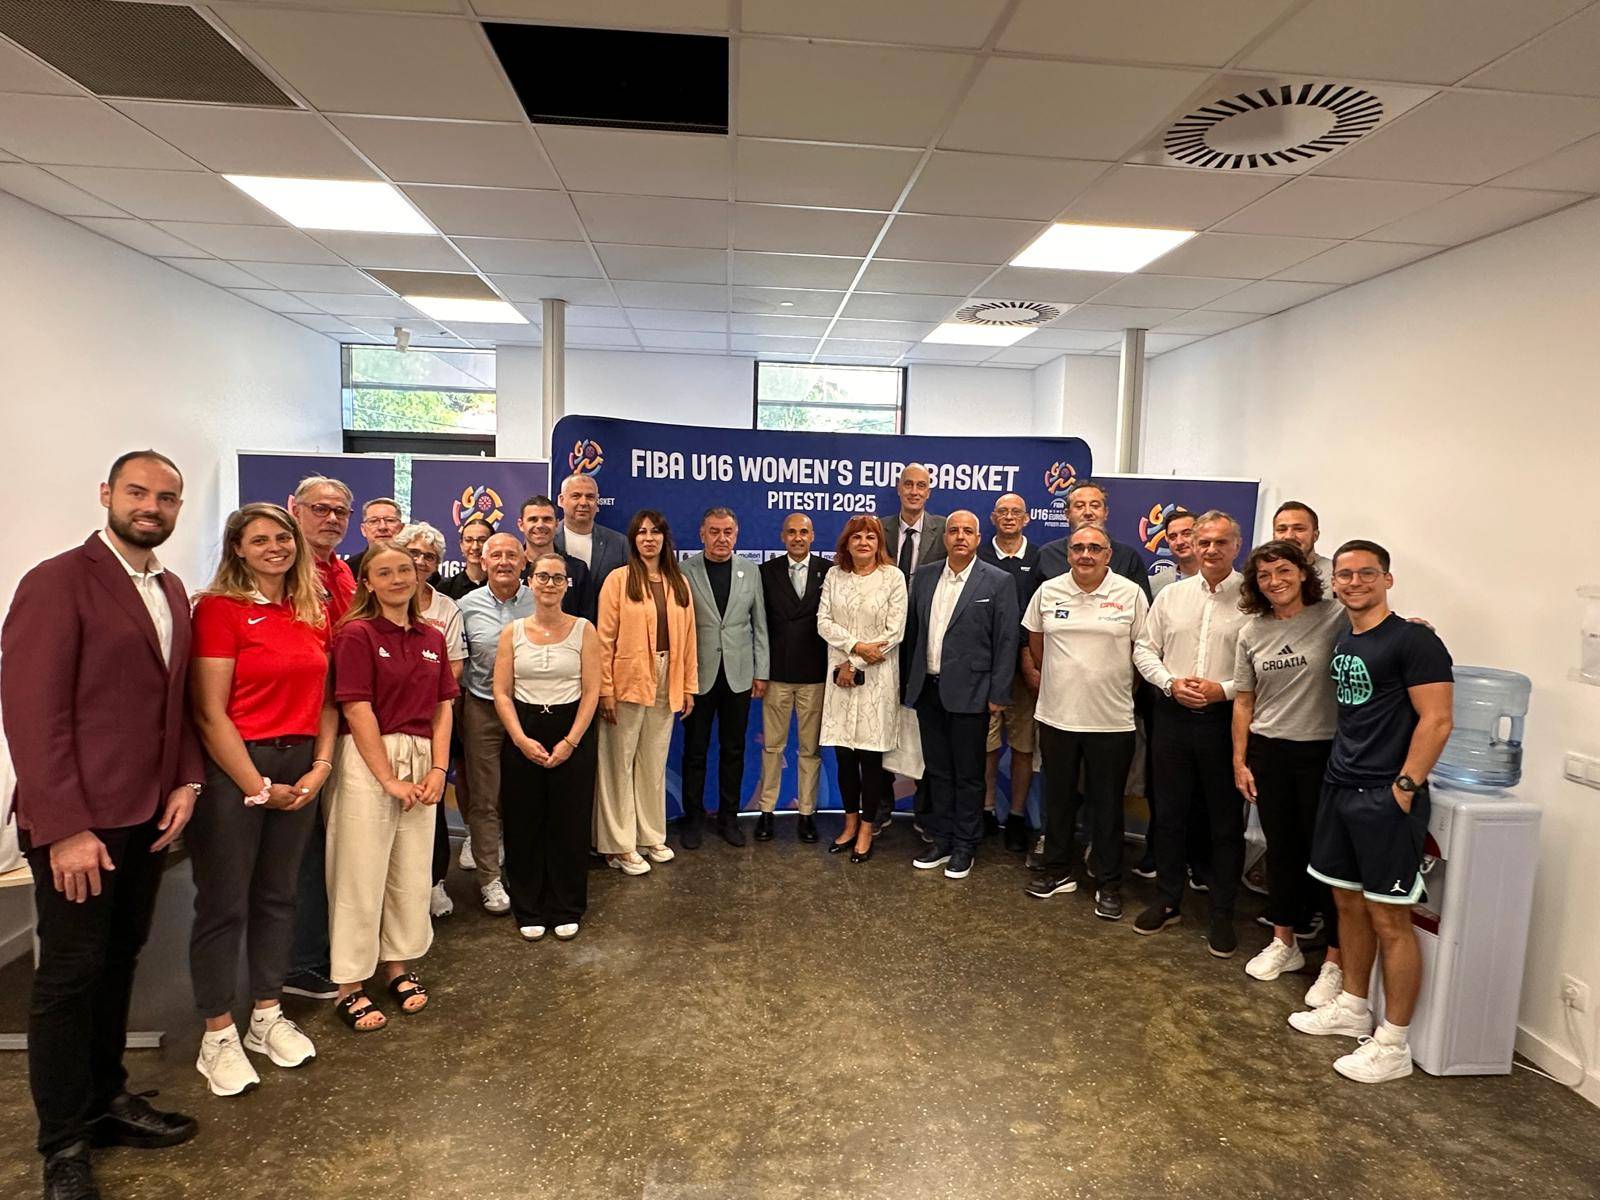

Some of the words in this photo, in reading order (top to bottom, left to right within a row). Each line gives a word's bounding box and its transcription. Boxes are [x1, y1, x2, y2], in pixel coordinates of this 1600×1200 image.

[631, 448, 685, 480] FIBA
[691, 453, 733, 482] U16
[738, 455, 853, 486] WOMEN'S
[859, 460, 1020, 492] EURBASKET
[767, 490, 830, 511] PITESTI
[832, 493, 877, 513] 2025
[1030, 508, 1049, 521] U16
[1262, 655, 1308, 671] CROATIA
